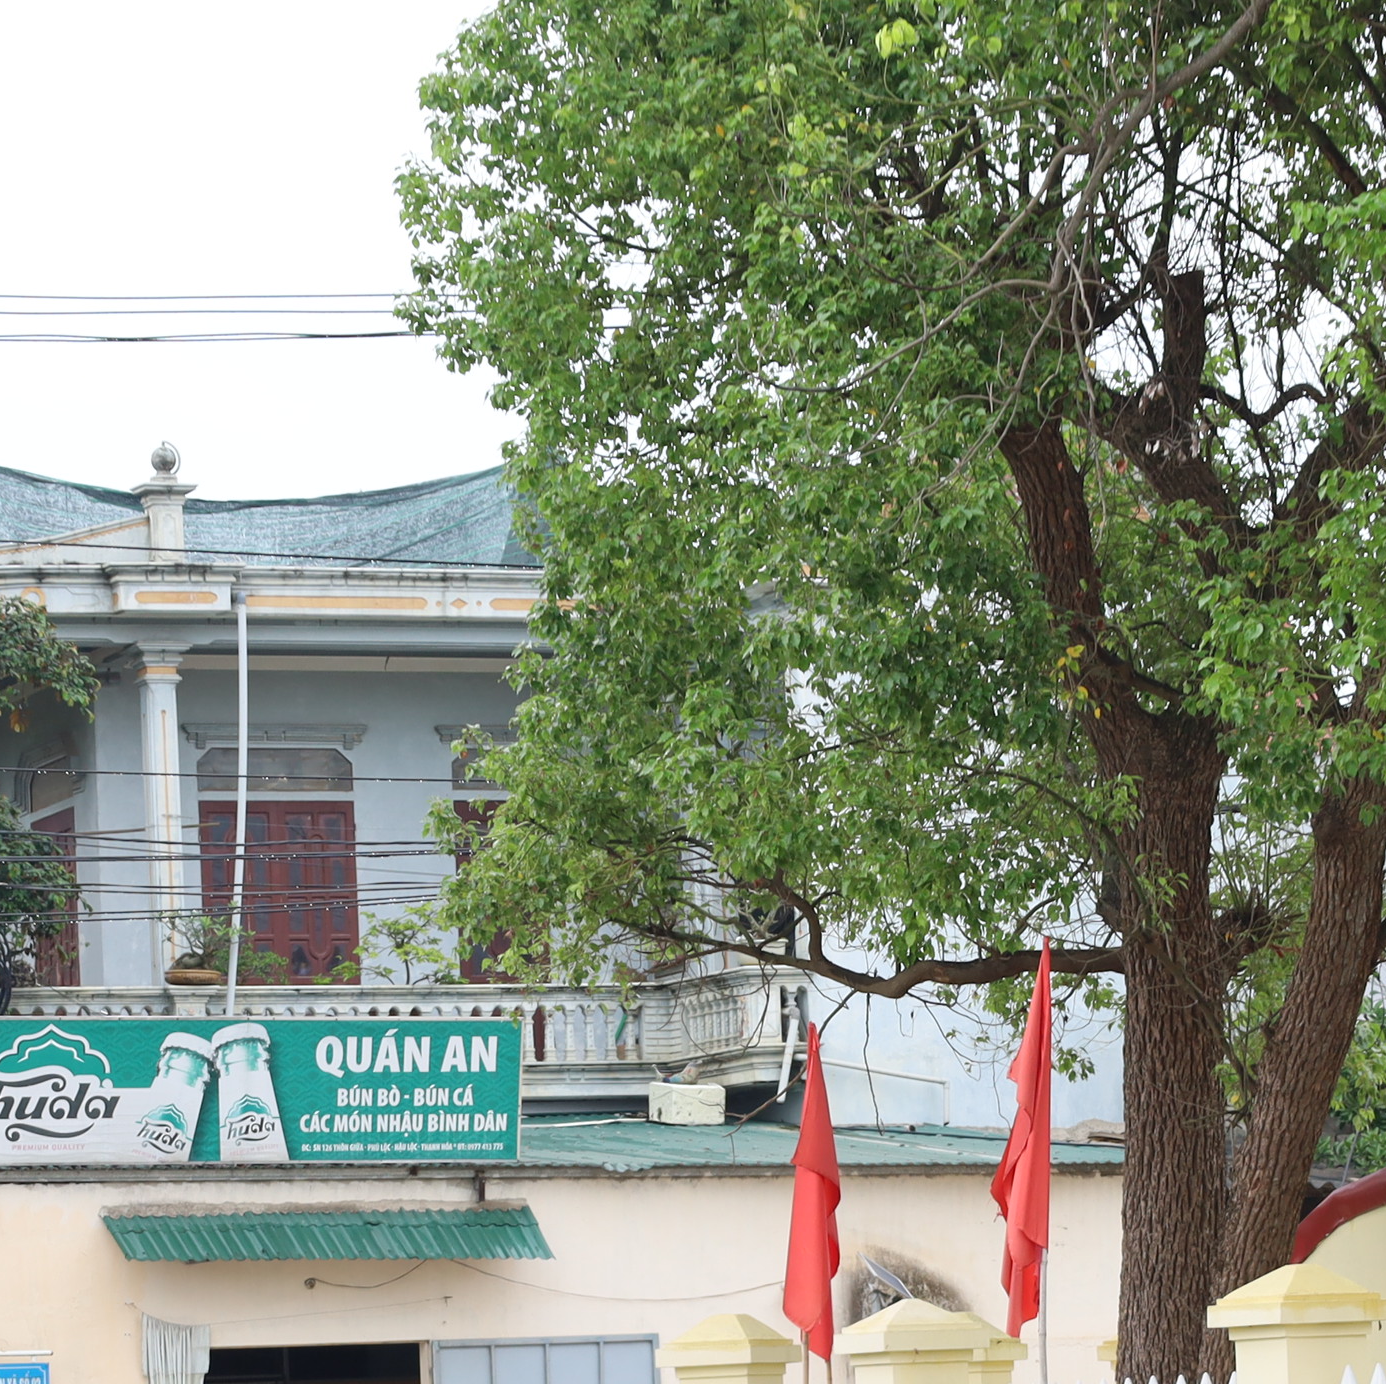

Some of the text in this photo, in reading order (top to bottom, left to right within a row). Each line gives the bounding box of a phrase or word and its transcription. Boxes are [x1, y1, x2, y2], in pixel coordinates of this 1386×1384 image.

[315, 1028, 498, 1078] QUÁN AN
[337, 1084, 373, 1107] BÚN
[377, 1084, 401, 1107] BÒ
[413, 1084, 449, 1107] BÚN
[452, 1083, 474, 1107] CÁ
[299, 1110, 508, 1137] CÁC MÓN NHẬU BÌNH DÂN
